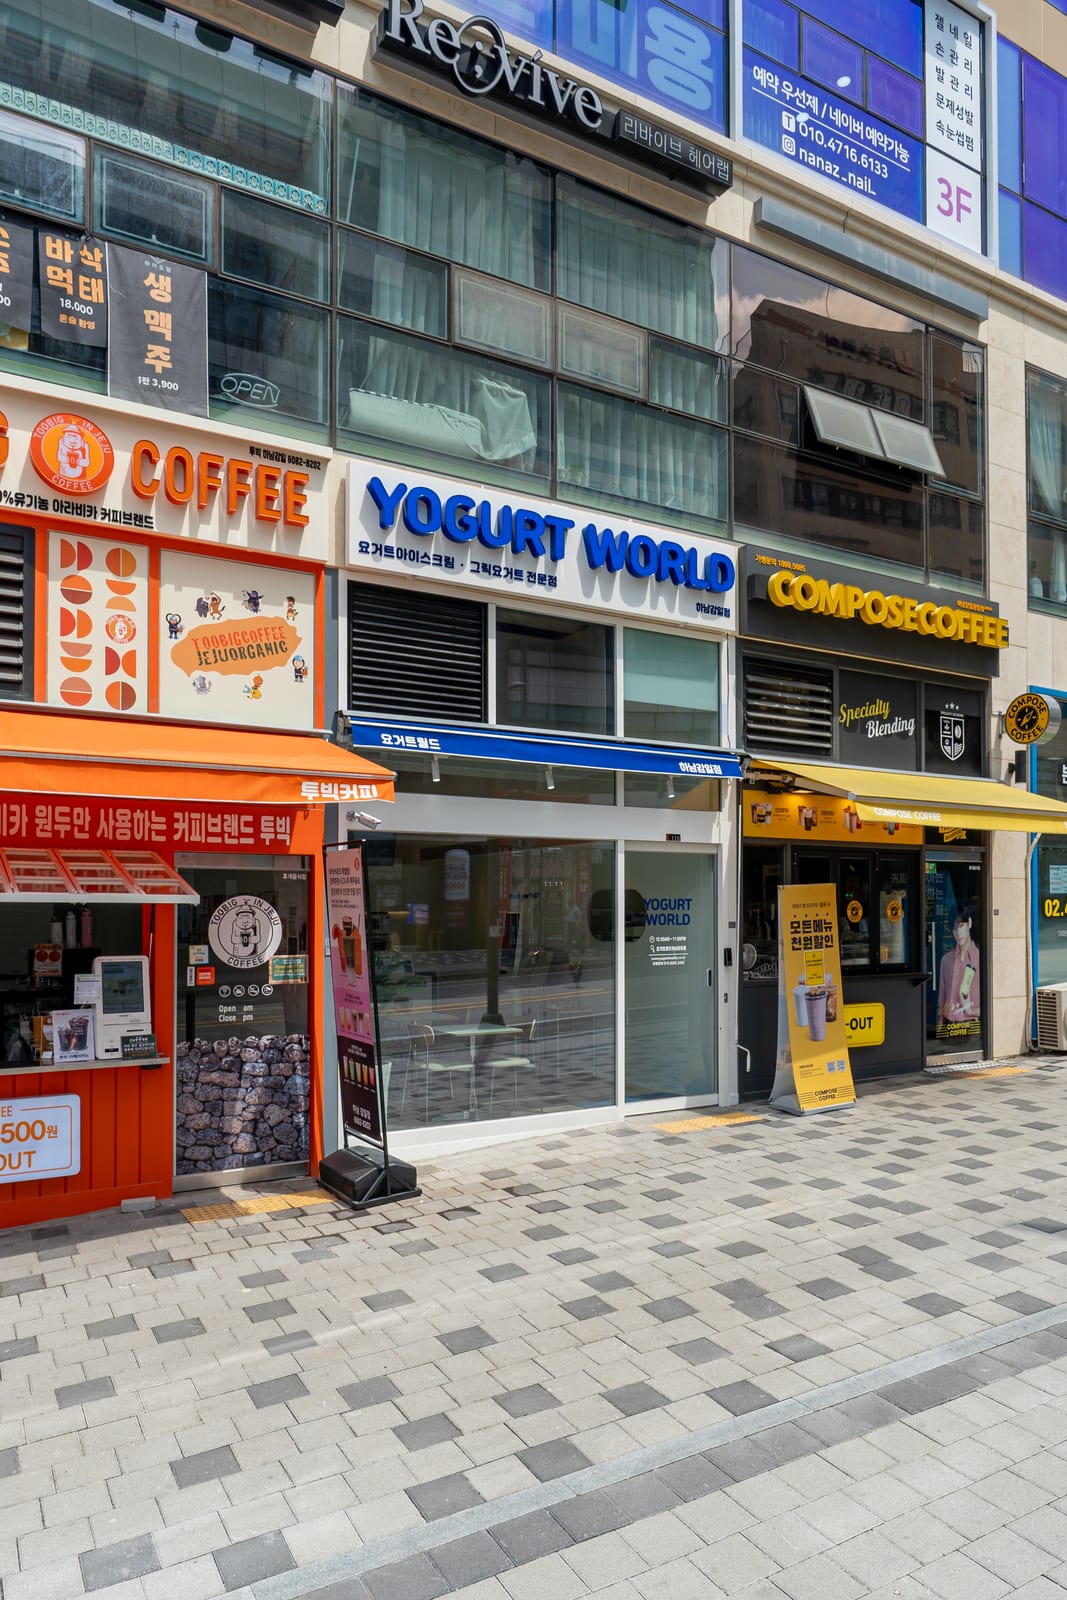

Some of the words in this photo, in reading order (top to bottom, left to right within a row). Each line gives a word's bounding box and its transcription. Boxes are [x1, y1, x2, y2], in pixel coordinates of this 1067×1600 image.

[752, 65, 780, 95] 예약
[781, 81, 819, 116] 우선제
[829, 106, 864, 140] 네이버
[865, 126, 910, 164] 예약가능
[624, 116, 683, 159] 리바이브
[688, 146, 729, 181] 헤어랩
[936, 119, 974, 153] 속눈썹펌
[799, 122, 888, 179] 010.4716.6133
[936, 176, 973, 223] 3F
[45, 235, 104, 273] 바삭
[46, 265, 105, 304] 먹태
[59, 297, 94, 316] 18.000
[143, 271, 173, 375] 생맥주
[152, 380, 179, 392] 3,900
[220, 376, 281, 404] OPEN
[33, 414, 65, 440] TOOBIG
[82, 420, 94, 432] IN
[93, 429, 112, 454] JEJU
[51, 474, 94, 492] COFFEE
[130, 439, 310, 528] COFFEE
[52, 498, 98, 520] 아라비카
[100, 507, 155, 530] 커피브랜드
[366, 476, 576, 563] YOGURT
[581, 523, 736, 593] WORLD
[358, 540, 455, 570] 요거트아이스크림
[470, 560, 525, 586] 그릭요거트
[526, 569, 558, 589] 전문점
[838, 698, 890, 728] Specialty
[1008, 695, 1047, 720] COMPOSE
[865, 716, 916, 738] Blending
[1010, 724, 1043, 742] COFFEE
[380, 733, 442, 750] 요거트월드
[678, 761, 723, 776] 하남감일점
[300, 781, 379, 801] 투빅커피
[35, 804, 92, 840] 원두만
[96, 807, 167, 842] 사용하는
[173, 811, 254, 845] 커피브랜드
[260, 815, 290, 846] 투빅
[210, 898, 238, 926] TOOBIG
[253, 898, 264, 909] IN
[263, 904, 281, 926] JEJU
[643, 898, 693, 911] YOGURT
[645, 913, 691, 926] WORLD
[790, 919, 833, 935] 모든메뉴
[791, 934, 834, 951] 천원할인
[227, 956, 264, 967] COFFEE
[218, 1004, 237, 1014] Open
[218, 1014, 237, 1022] Close
[242, 1014, 254, 1023] pm
[814, 1087, 838, 1097] COMPOSE
[818, 1094, 837, 1102] COFFEE
